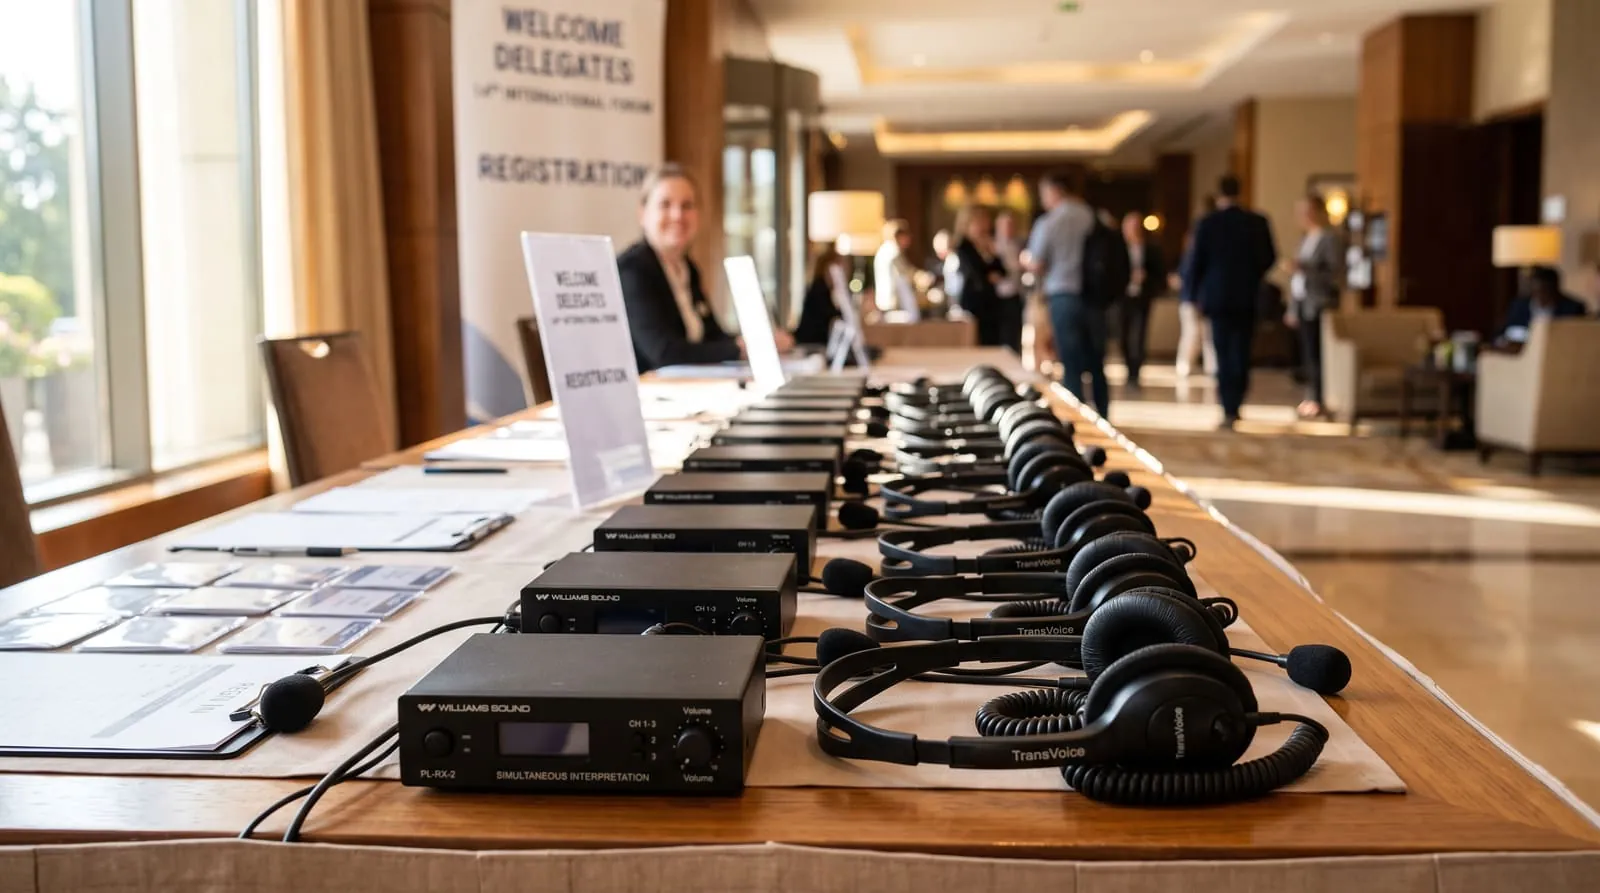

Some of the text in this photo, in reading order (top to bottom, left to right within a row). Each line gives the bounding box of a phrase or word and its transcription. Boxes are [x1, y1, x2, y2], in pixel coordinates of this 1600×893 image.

[503, 9, 623, 47] WELCOME
[494, 43, 634, 84] DELEGATES
[554, 271, 599, 287] WELCOME
[556, 293, 606, 310] DELEGATES
[1016, 558, 1061, 568] TransVoice
[1017, 625, 1074, 637] TransVoice
[438, 704, 531, 713] WILLIAMS SOUND
[683, 706, 712, 715] Volume
[629, 720, 657, 728] CH 1-3
[1176, 707, 1184, 759] TransVoice
[651, 736, 656, 744] 2
[651, 752, 656, 760] 3
[1012, 745, 1085, 763] TransVoice
[420, 769, 456, 779] PL-RX-2
[496, 771, 650, 783] SIMULTANEOUS INTERPRETATION
[684, 774, 713, 783] Volume
